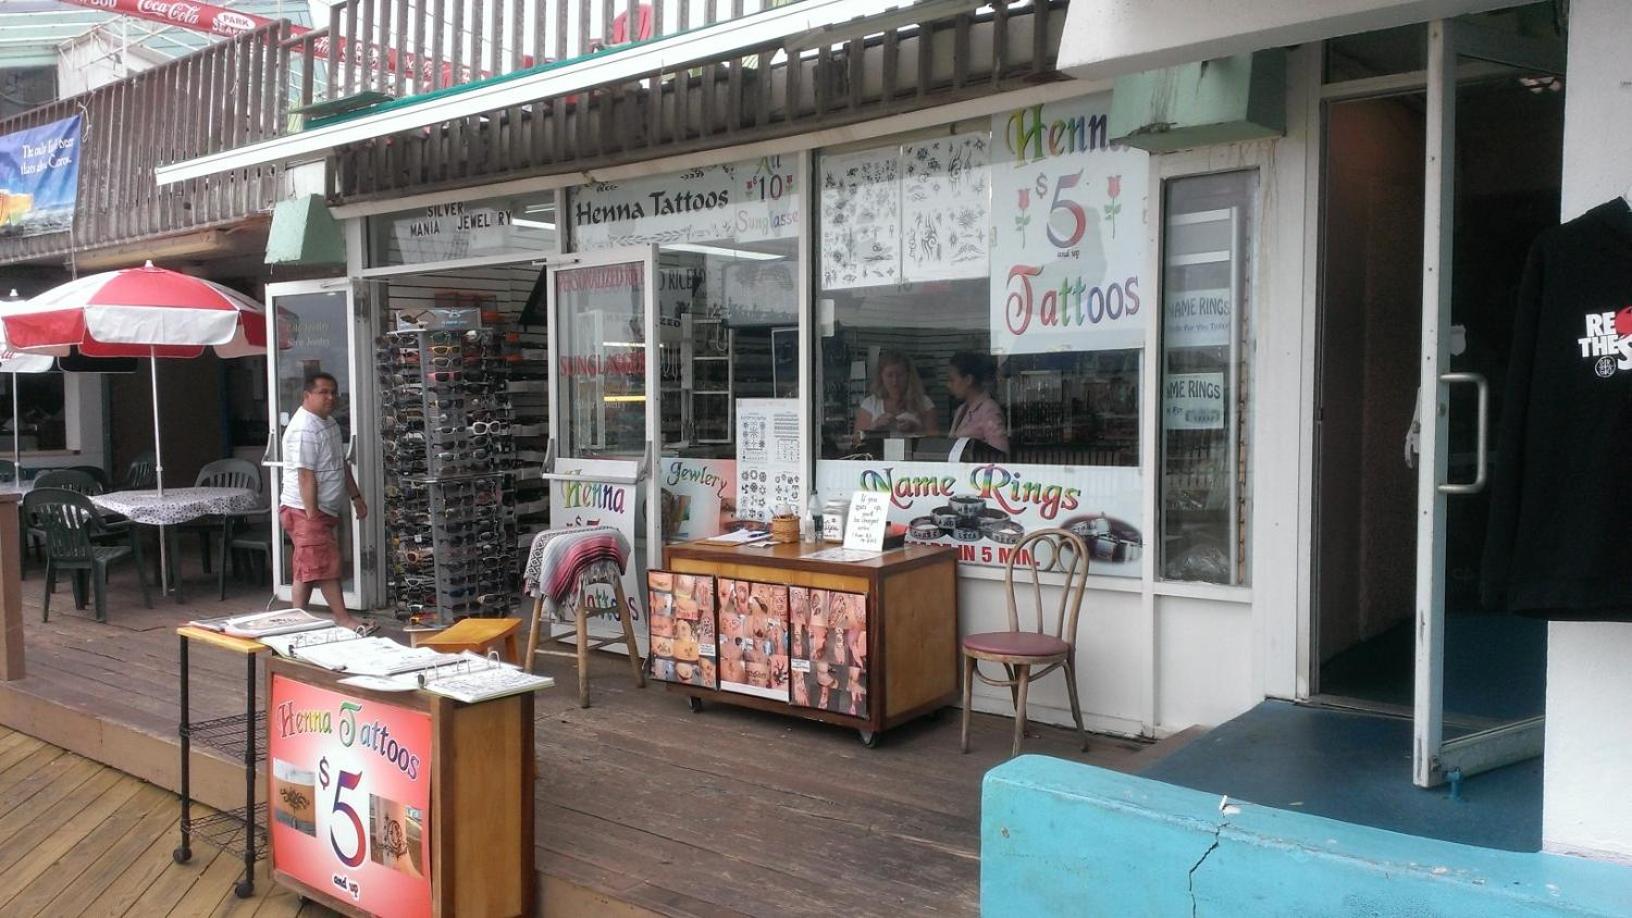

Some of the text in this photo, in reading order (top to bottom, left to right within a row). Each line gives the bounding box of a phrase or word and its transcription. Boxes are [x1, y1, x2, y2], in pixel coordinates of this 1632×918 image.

[1005, 101, 1130, 168] Henn
[427, 202, 464, 218] SILVER
[575, 189, 729, 226] Henna Tattoos
[410, 221, 440, 237] MANIA
[1006, 263, 1140, 337] Tattoos
[1188, 380, 1221, 399] RINGS
[561, 469, 626, 514] Henna
[859, 464, 1082, 521] Name Rings
[959, 544, 976, 562] IN
[981, 546, 993, 563] 5
[279, 701, 420, 780] Henna Tattoos
[333, 874, 360, 899] and up
